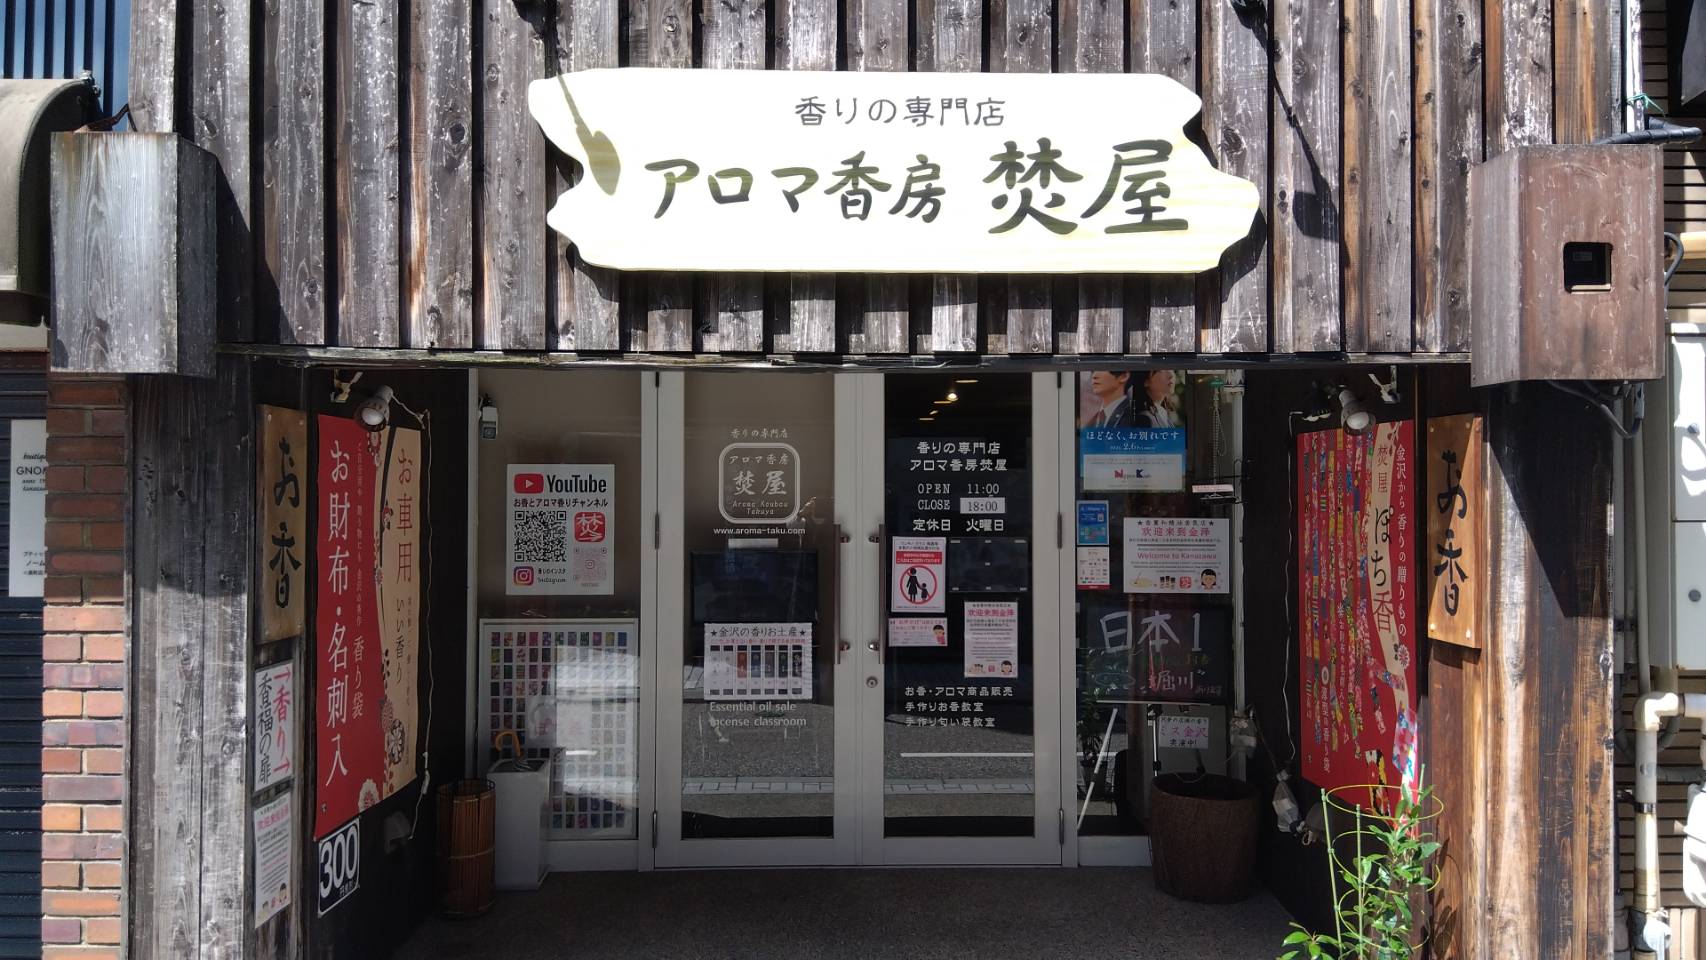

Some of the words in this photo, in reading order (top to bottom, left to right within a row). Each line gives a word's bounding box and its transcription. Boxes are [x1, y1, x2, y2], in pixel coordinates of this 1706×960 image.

[794, 97, 1006, 127] 香りの専門店
[645, 152, 946, 223] アロマ香房
[980, 137, 1189, 236] 焚屋
[730, 428, 789, 438] 香りの専門店
[1086, 431, 1180, 441] ほどなく、お別れです
[917, 441, 1001, 455] 香りの専門店
[729, 453, 789, 465] アロマ香房
[910, 458, 1008, 472] アロマ香房焚屋
[546, 474, 607, 493] YouTube
[732, 470, 788, 495] 焚屋
[917, 483, 951, 494] OPEN
[967, 483, 1000, 494] 11:00
[513, 498, 608, 508] お香とアロマ香りチャンネル
[917, 499, 951, 511] CLOSE
[968, 501, 998, 512] 18:00
[269, 437, 302, 610] お香
[912, 519, 951, 532] 定休日
[966, 519, 1004, 532] 火曜日
[1434, 450, 1468, 617] お香
[1396, 447, 1408, 637] 金沢から香りの贈りもの
[1137, 552, 1170, 560] Welcome
[325, 440, 350, 786] お財布・名刺入
[719, 626, 798, 637] 金沢の香りお土産
[351, 635, 366, 719] 香り袋
[904, 686, 1014, 697] お香・アロマ商品販売
[709, 701, 756, 711] Essential
[758, 701, 772, 711] oil
[775, 701, 797, 711] sale
[904, 701, 984, 712] 手作りお香教室
[709, 717, 750, 726] ncense
[754, 716, 807, 726] classroom
[904, 717, 996, 727] 手作り匂い袋教室
[320, 825, 357, 898] 300
